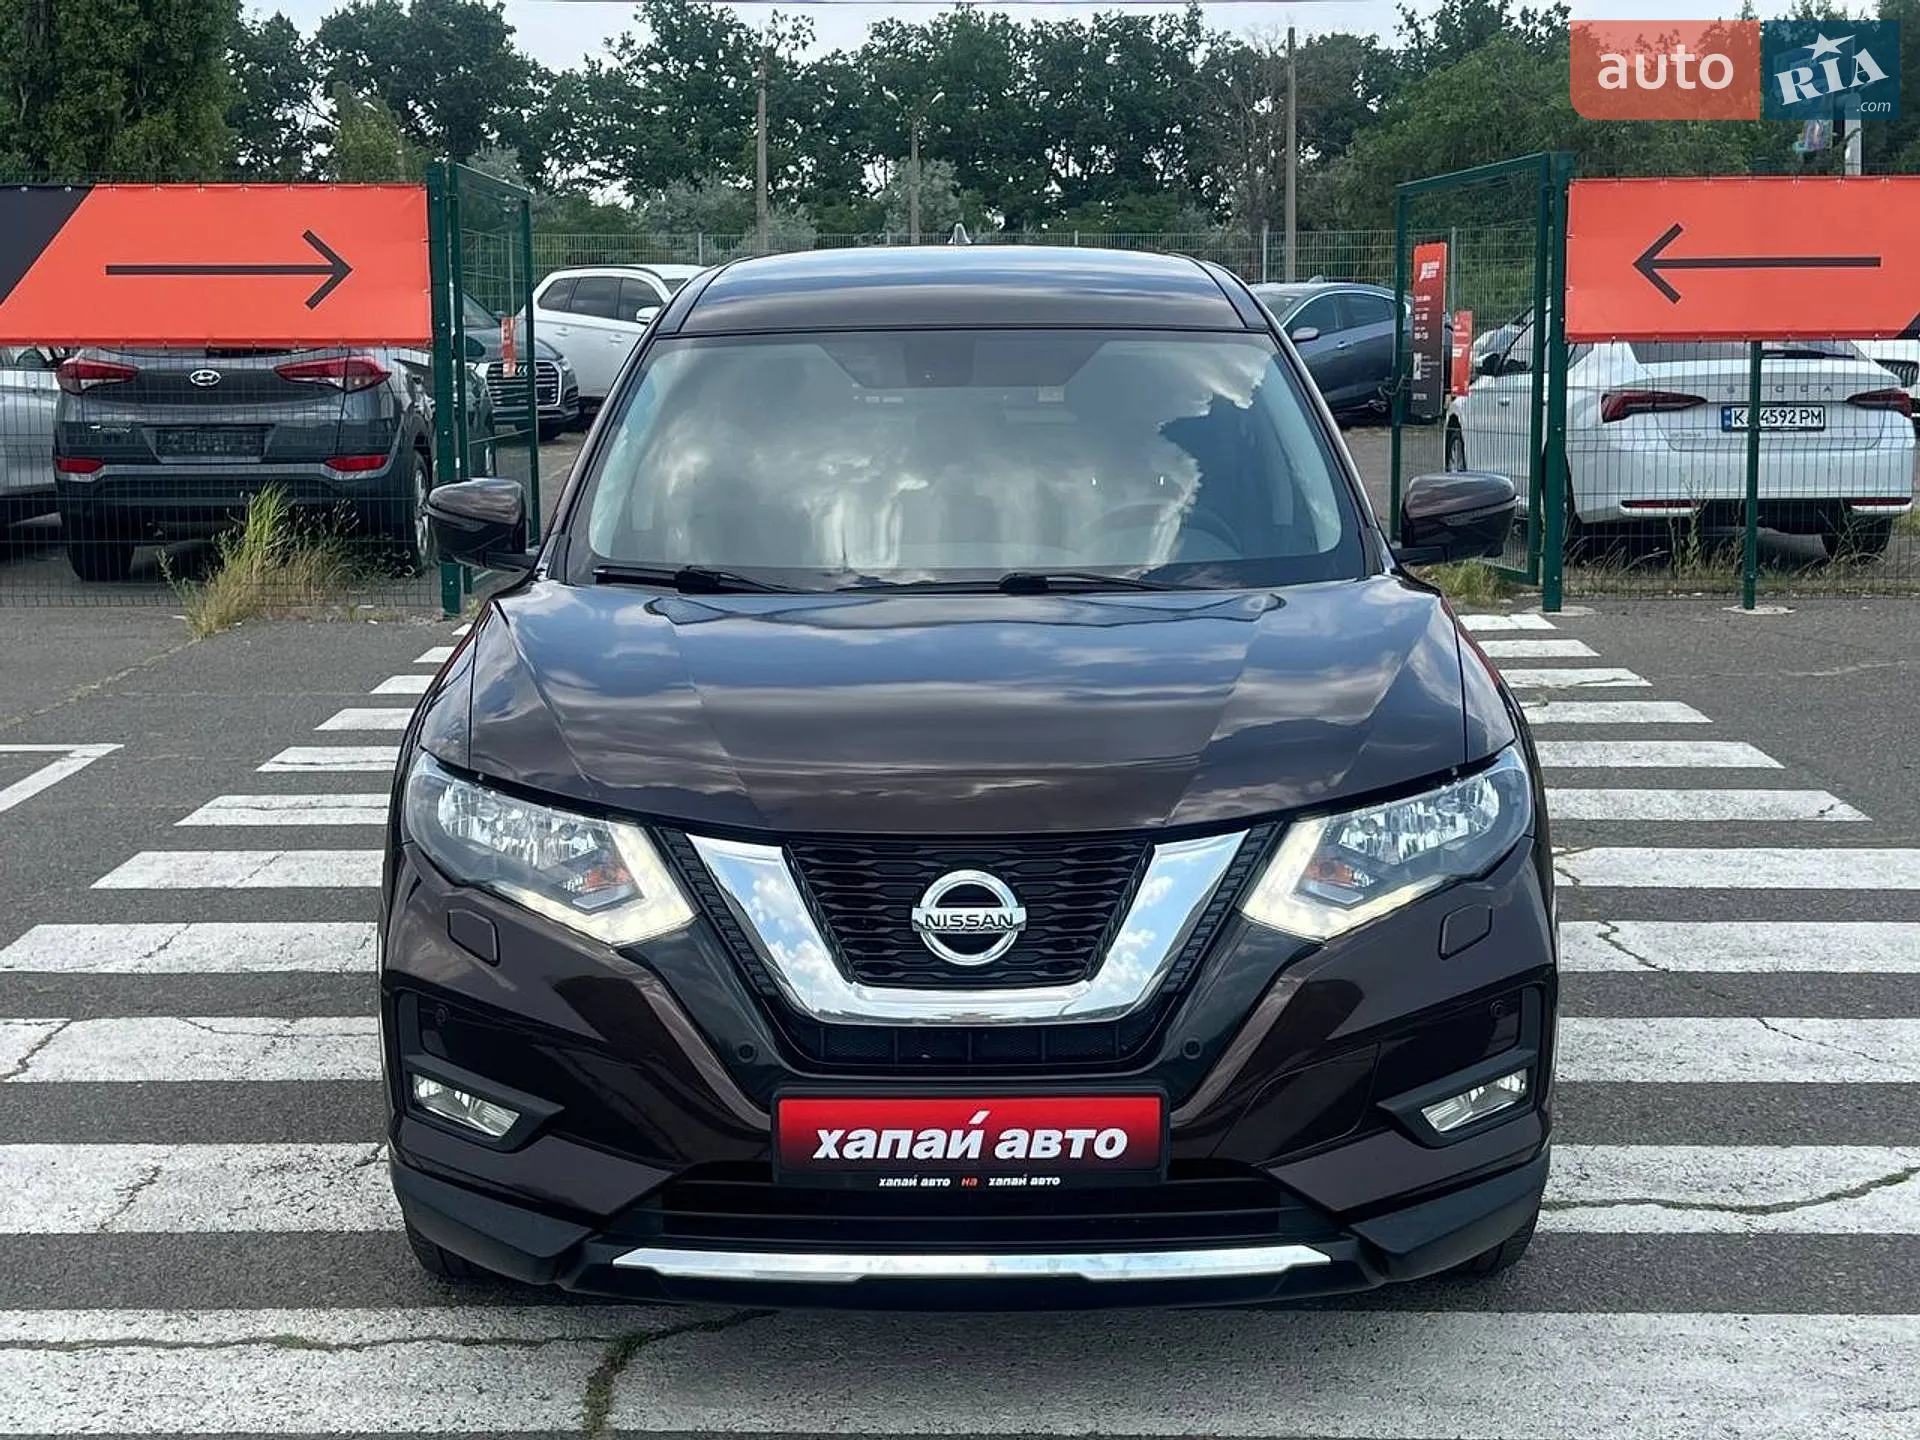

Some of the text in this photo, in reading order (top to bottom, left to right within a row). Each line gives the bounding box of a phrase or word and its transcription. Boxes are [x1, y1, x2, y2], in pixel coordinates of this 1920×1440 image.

[925, 913, 1014, 928] NISSAN
[994, 1128, 1128, 1160] авто
[920, 1177, 951, 1187] авто
[961, 1177, 978, 1187] на
[1030, 1176, 1061, 1186] авто
